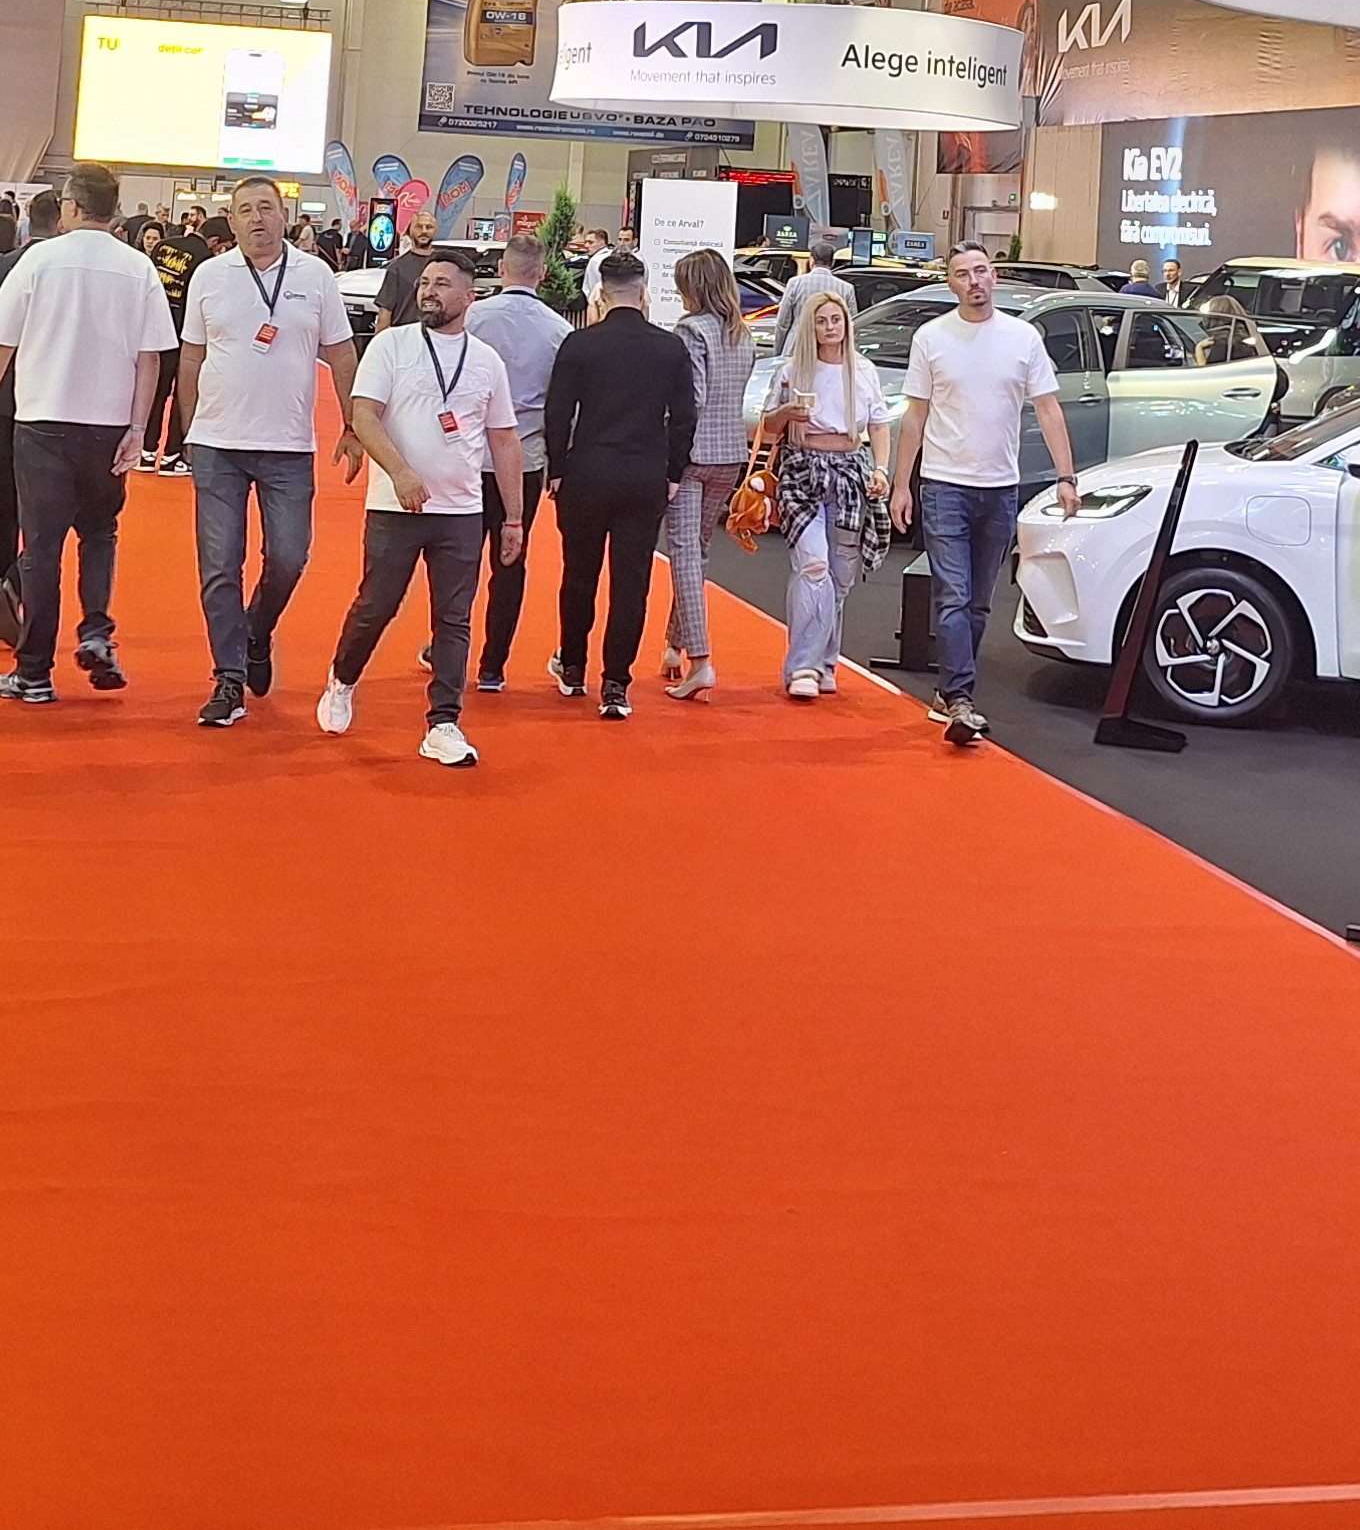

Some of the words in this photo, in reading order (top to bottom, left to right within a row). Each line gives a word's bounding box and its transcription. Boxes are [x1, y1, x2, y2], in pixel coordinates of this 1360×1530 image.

[98, 36, 120, 51] TU
[633, 21, 778, 61] KIA
[630, 68, 691, 83] Movement
[696, 70, 720, 84] that
[724, 70, 776, 87] inspires
[841, 43, 919, 79] Alege
[927, 50, 1008, 89] inteligent
[463, 104, 568, 121] TEHNOLOGIE
[633, 115, 678, 128] BAZA
[1123, 147, 1148, 181] Kia
[1149, 147, 1183, 181] EV2
